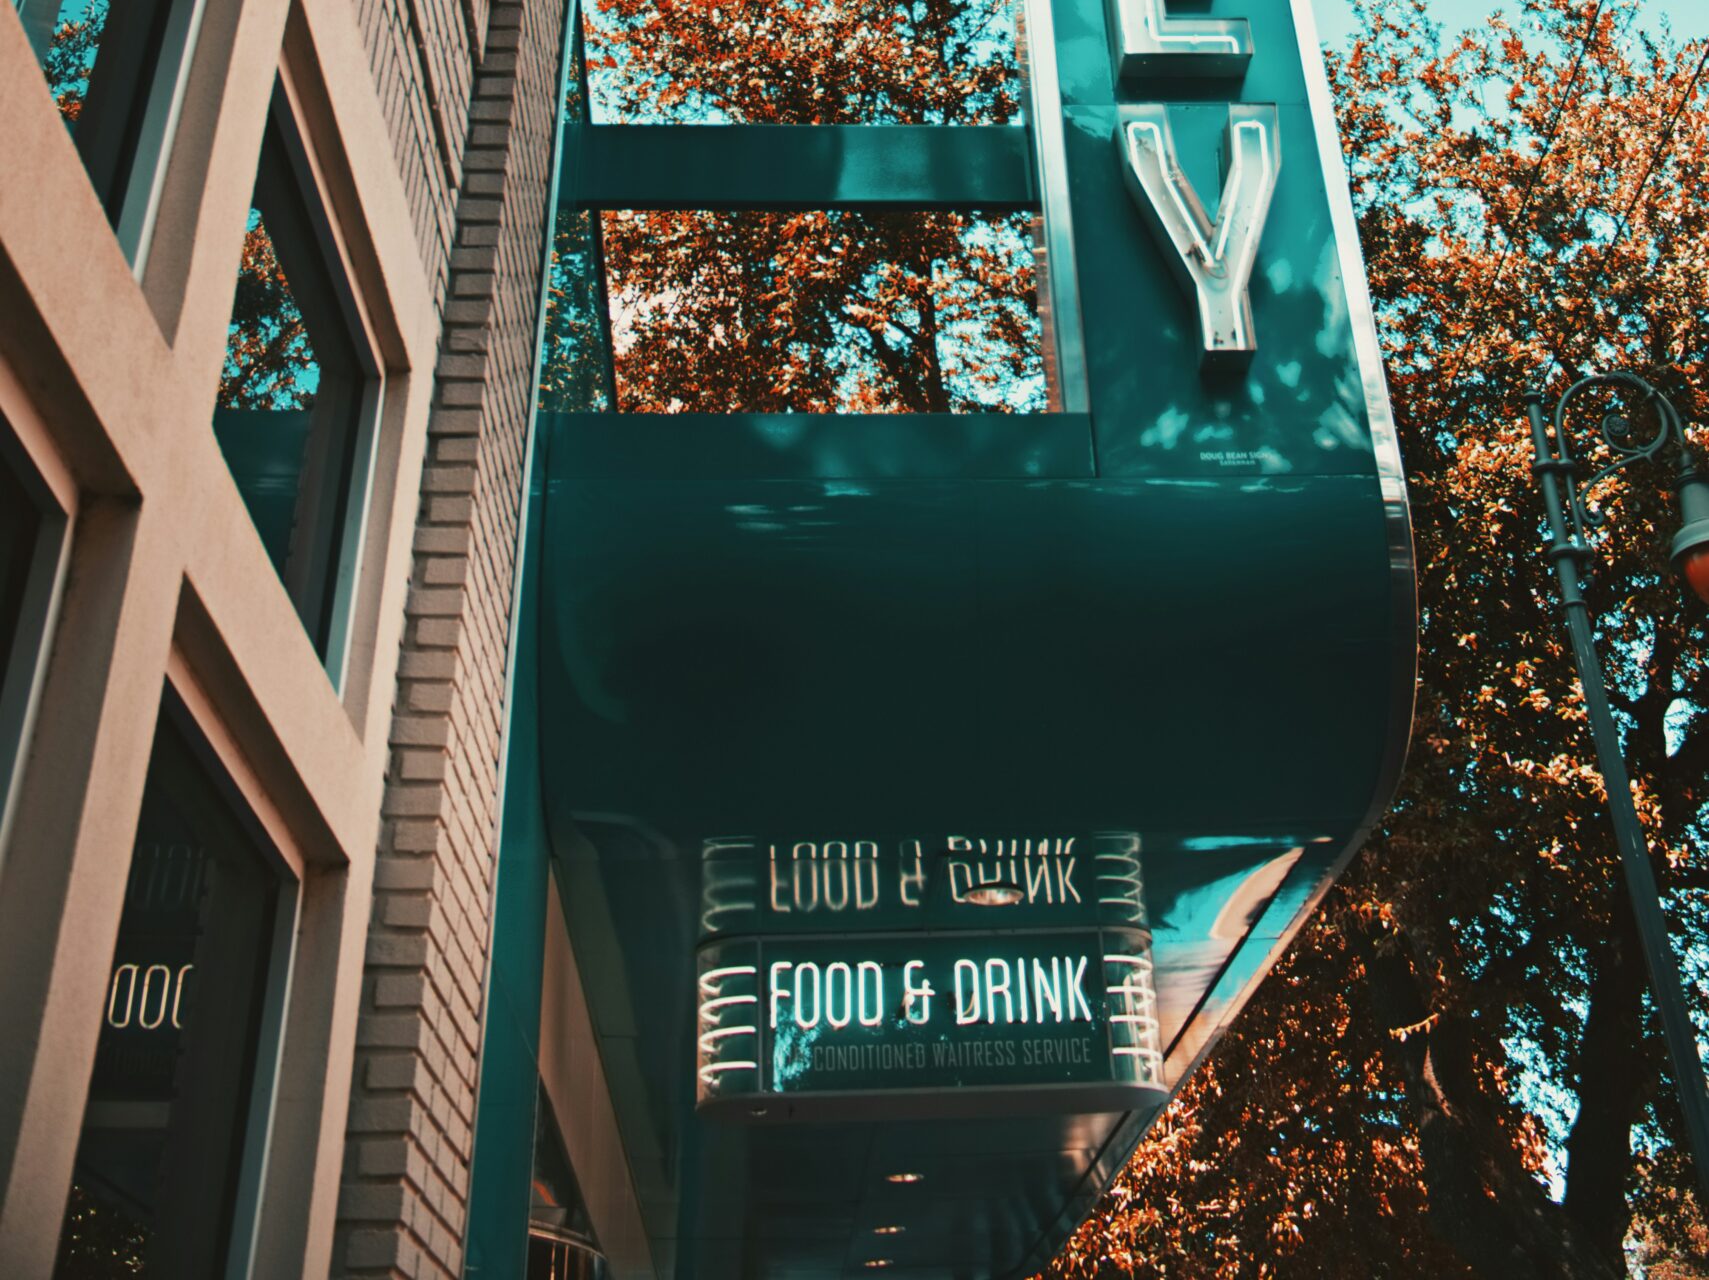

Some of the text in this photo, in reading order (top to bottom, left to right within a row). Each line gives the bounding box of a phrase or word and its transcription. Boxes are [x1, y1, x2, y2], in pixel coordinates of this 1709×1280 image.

[1225, 451, 1247, 460] BEAN
[770, 954, 1093, 1030] FOOD & DRINK
[814, 1043, 926, 1073] CONDITIONED
[931, 1039, 1017, 1068] WAITRESS
[1021, 1036, 1093, 1064] SERVICE
